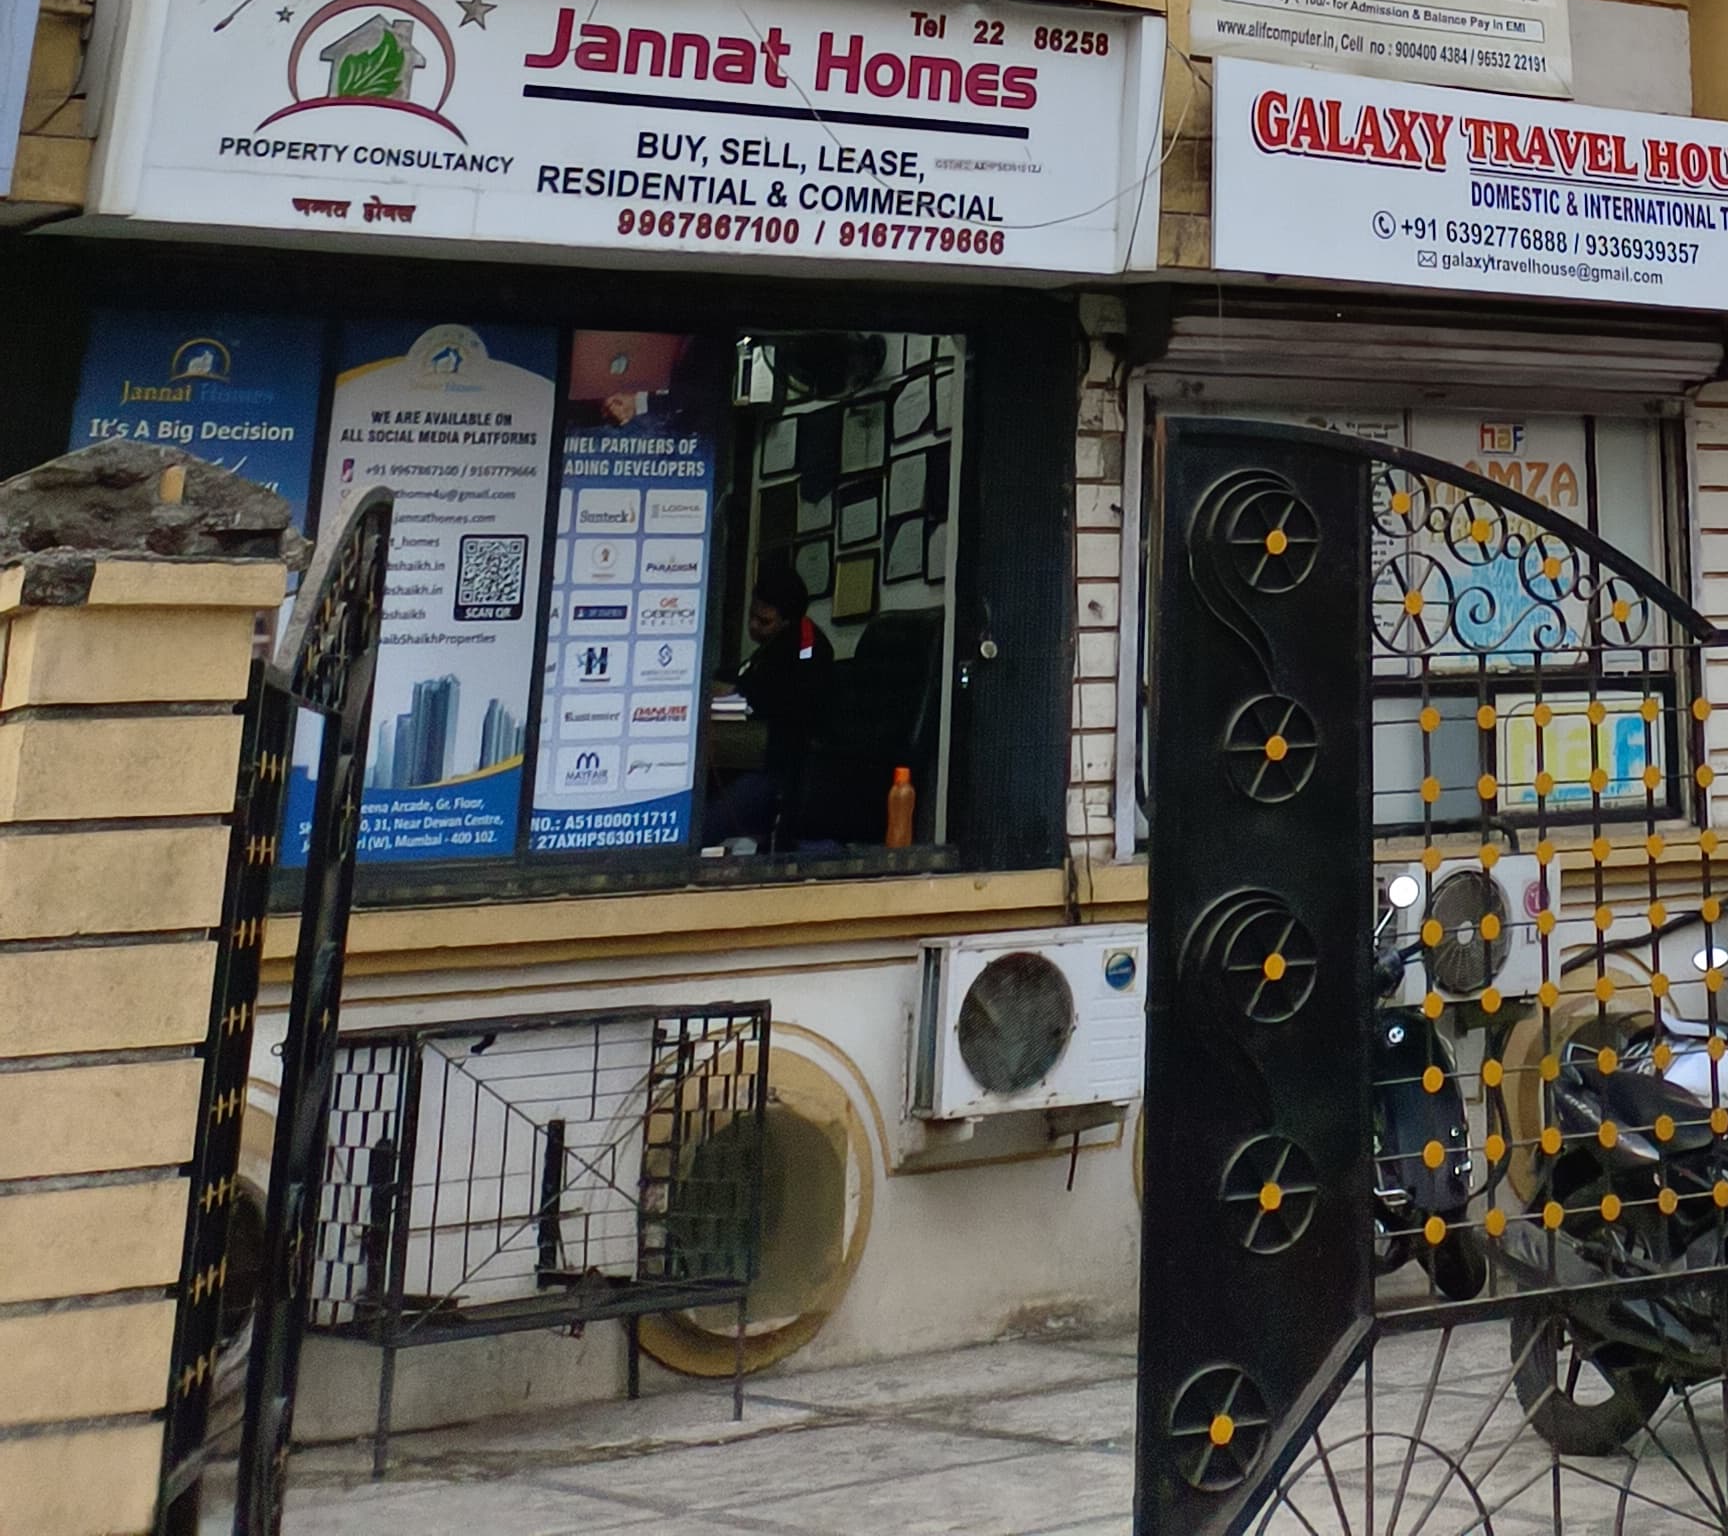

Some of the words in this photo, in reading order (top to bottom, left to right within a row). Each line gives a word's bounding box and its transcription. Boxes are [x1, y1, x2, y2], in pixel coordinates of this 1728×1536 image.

[910, 11, 946, 39] Tel
[973, 19, 1005, 46] 22
[1034, 26, 1109, 56] 86258
[524, 7, 791, 89] Jannat
[814, 31, 1038, 110] Homes
[1252, 90, 1454, 172] GALAXY
[1461, 116, 1639, 178] TRAVEL
[219, 136, 349, 163] PROPERTY
[353, 145, 514, 175] CONSULTANCY
[637, 131, 709, 168] BUY,
[720, 137, 807, 175] SELL,
[817, 145, 925, 185] LEASE,
[537, 164, 757, 207] RESIDENTIAL
[799, 183, 1004, 223] COMMERCIAL
[1471, 181, 1560, 217] DOMESTIC
[1584, 192, 1716, 230] INTERNATIONAL
[617, 208, 800, 245] 9967867100
[839, 221, 1005, 255] 9167779666
[1400, 218, 1437, 241] +91
[1445, 219, 1567, 254] 6392776888
[1586, 234, 1700, 265] 9336939357
[1442, 250, 1664, 285] galaxytravelhouse@gmail.com
[89, 418, 129, 438] It's
[158, 420, 194, 444] Big
[201, 421, 294, 441] Decision
[395, 411, 421, 425] ARE
[424, 411, 491, 426] AVAILABLE
[340, 429, 363, 443] ALL
[367, 429, 414, 443] SOCIAL
[418, 430, 460, 444] MEDIA
[463, 432, 537, 446] PLATFORMS
[600, 437, 674, 454] PARTNERS
[564, 460, 609, 476] ADING
[613, 460, 705, 477] DEVELOPERS
[465, 608, 494, 619] SCAN
[391, 800, 434, 813] Arcade,
[424, 817, 462, 828] Dewan
[565, 811, 677, 829] A51800011711
